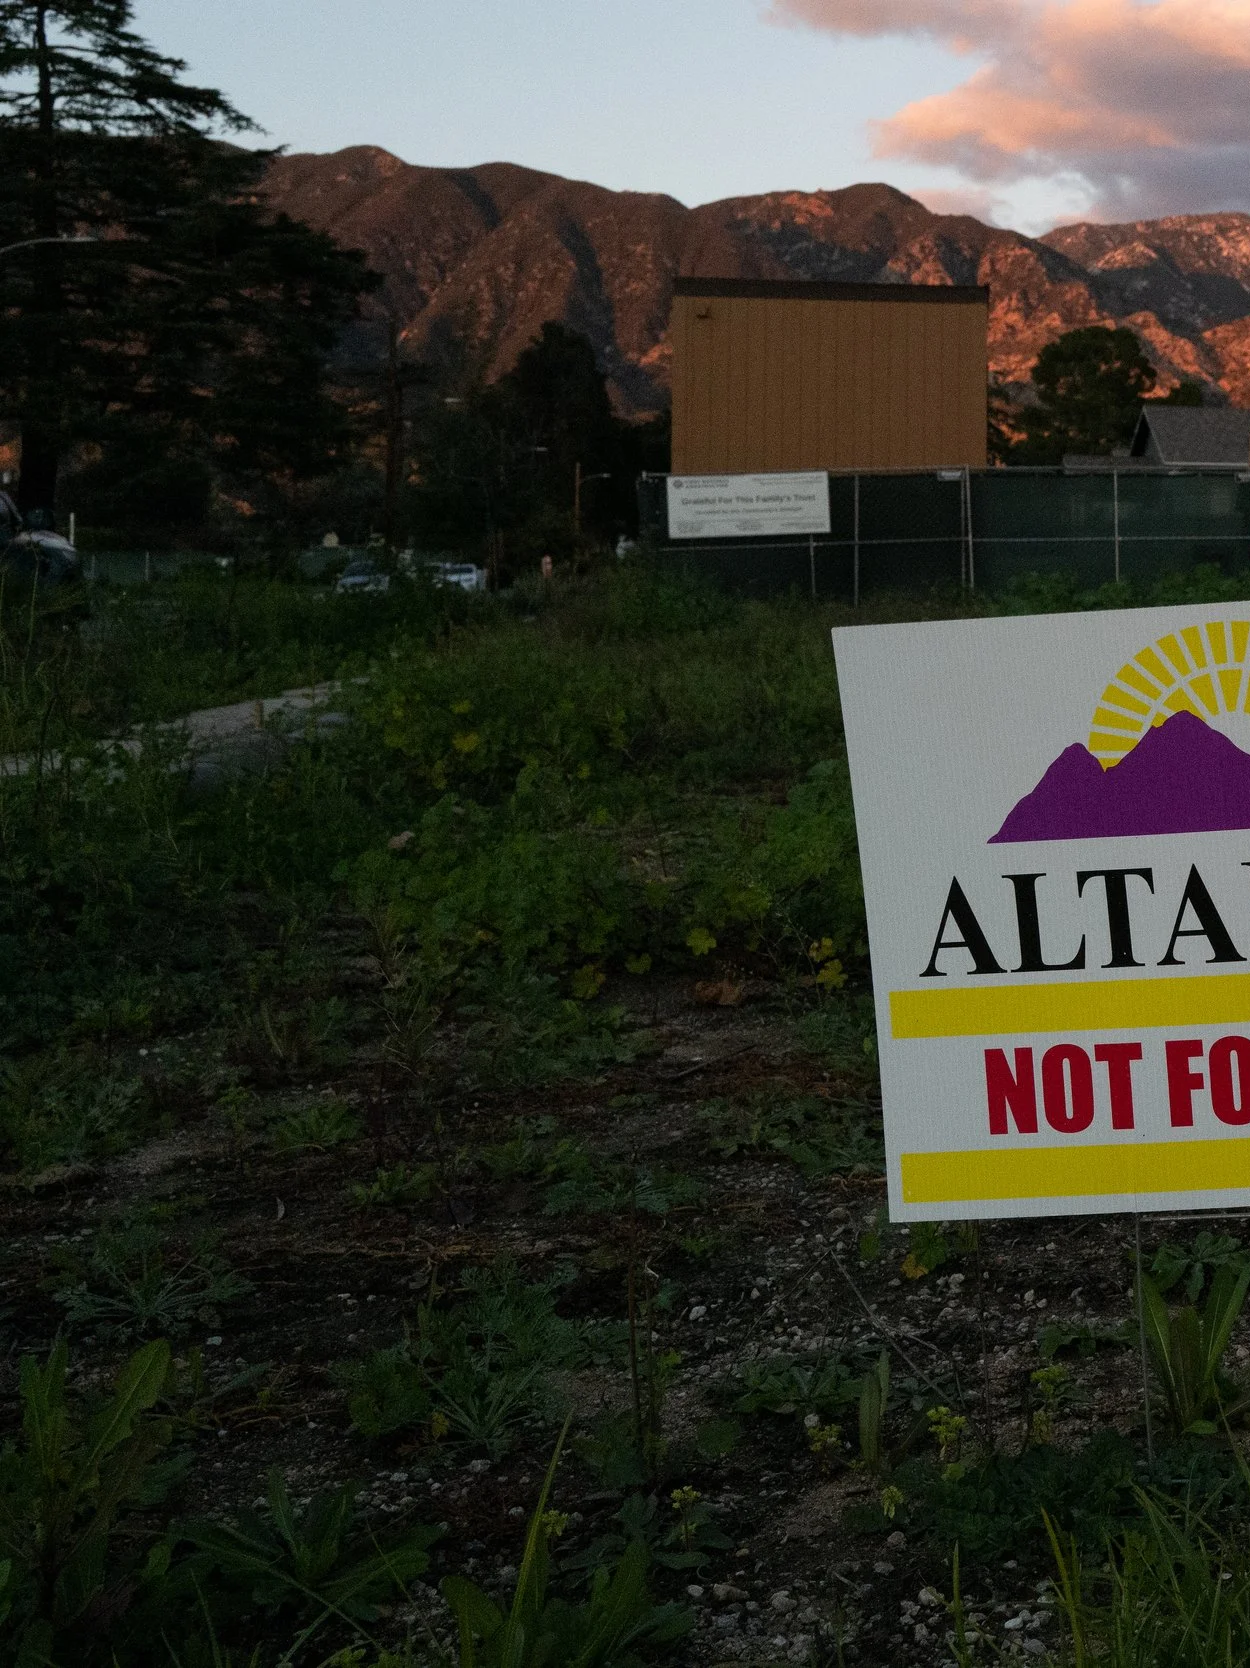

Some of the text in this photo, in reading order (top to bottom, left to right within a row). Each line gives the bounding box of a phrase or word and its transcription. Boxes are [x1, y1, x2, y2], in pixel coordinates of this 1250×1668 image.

[682, 497, 716, 505] Grateful
[735, 495, 754, 503] This
[984, 1042, 1142, 1135] NOT
